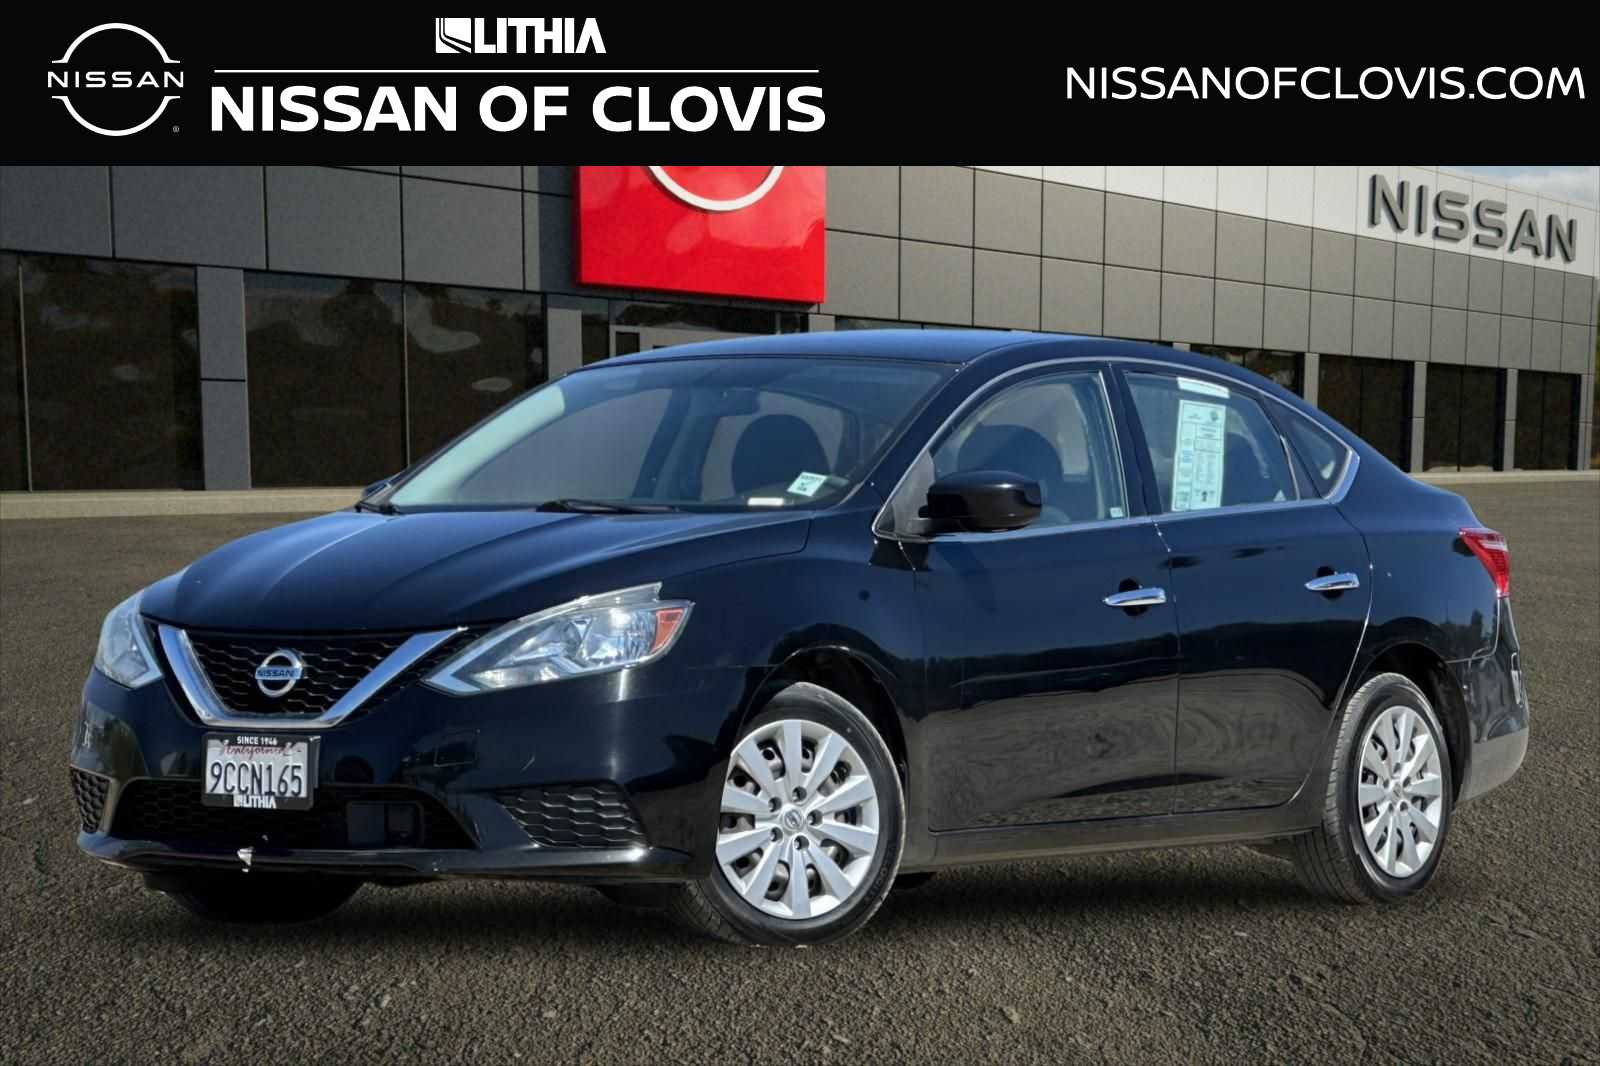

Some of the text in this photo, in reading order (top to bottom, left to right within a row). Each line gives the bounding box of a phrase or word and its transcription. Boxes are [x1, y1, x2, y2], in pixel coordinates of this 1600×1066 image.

[1369, 173, 1577, 263] NISSAN
[257, 668, 295, 678] NISSAN
[236, 735, 259, 745] SINCE
[209, 761, 303, 797] 9CCN165
[241, 795, 277, 809] LITHIA
